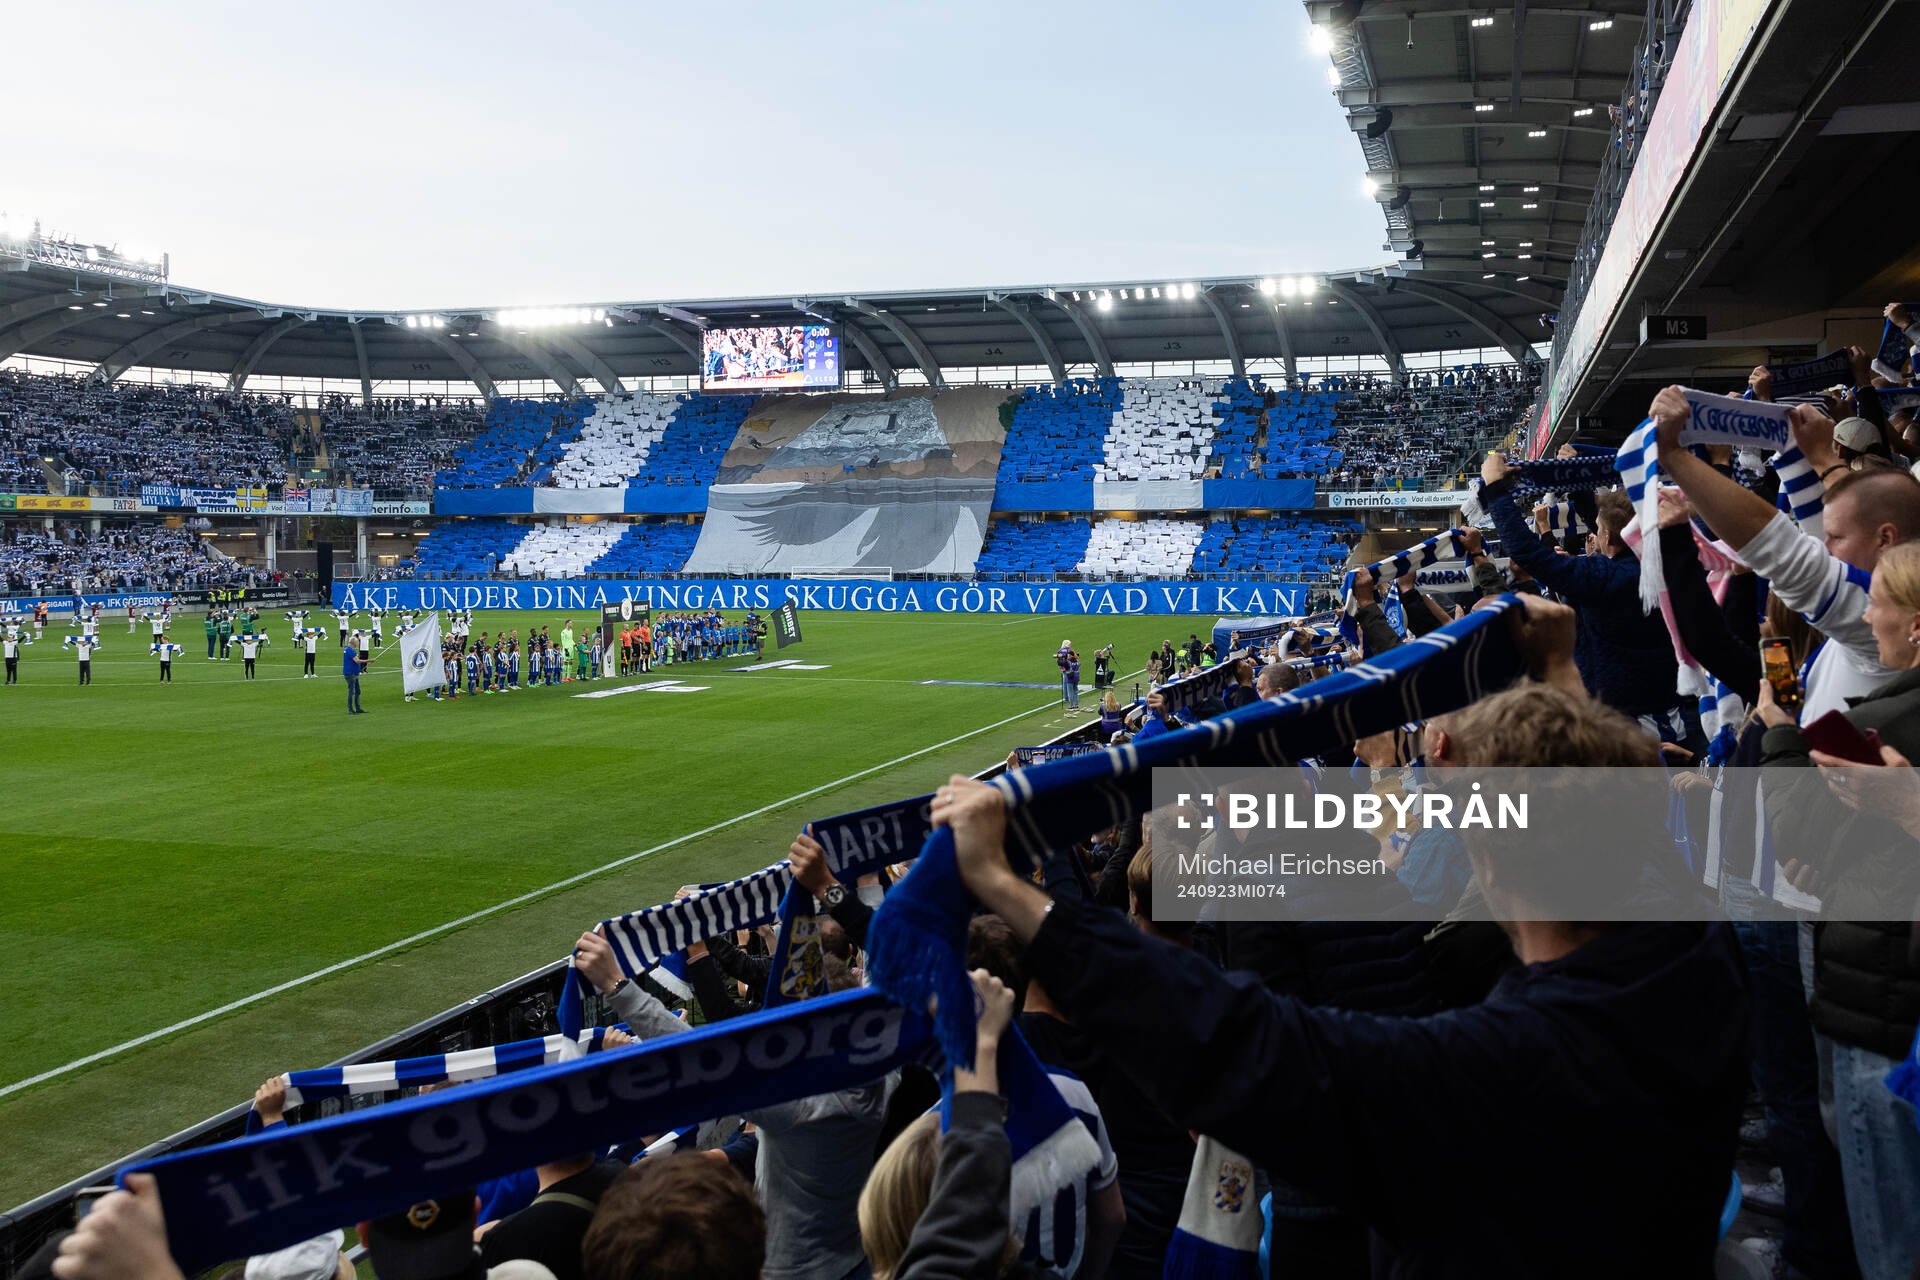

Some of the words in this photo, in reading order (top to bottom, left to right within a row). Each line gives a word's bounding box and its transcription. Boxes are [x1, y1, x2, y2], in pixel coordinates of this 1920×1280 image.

[1666, 319, 1689, 336] M3
[1163, 341, 1182, 350] J3
[1330, 335, 1353, 345] J2
[984, 347, 1003, 356] J4
[649, 357, 672, 367] H3
[113, 499, 137, 510] FAT21
[1345, 494, 1407, 506] merinfo.se
[107, 598, 121, 607] IFK
[417, 586, 521, 610] UNDER
[532, 585, 608, 609] DINA
[621, 585, 771, 609] VINGARS
[783, 585, 923, 612] SKUGGA
[935, 582, 1009, 613] GÖR
[1023, 588, 1060, 613] VI
[1075, 588, 1148, 614] VAD
[1161, 588, 1199, 614] VI
[1217, 588, 1298, 615] KAN
[782, 604, 796, 638] UNIBET
[206, 1127, 390, 1226] ifk
